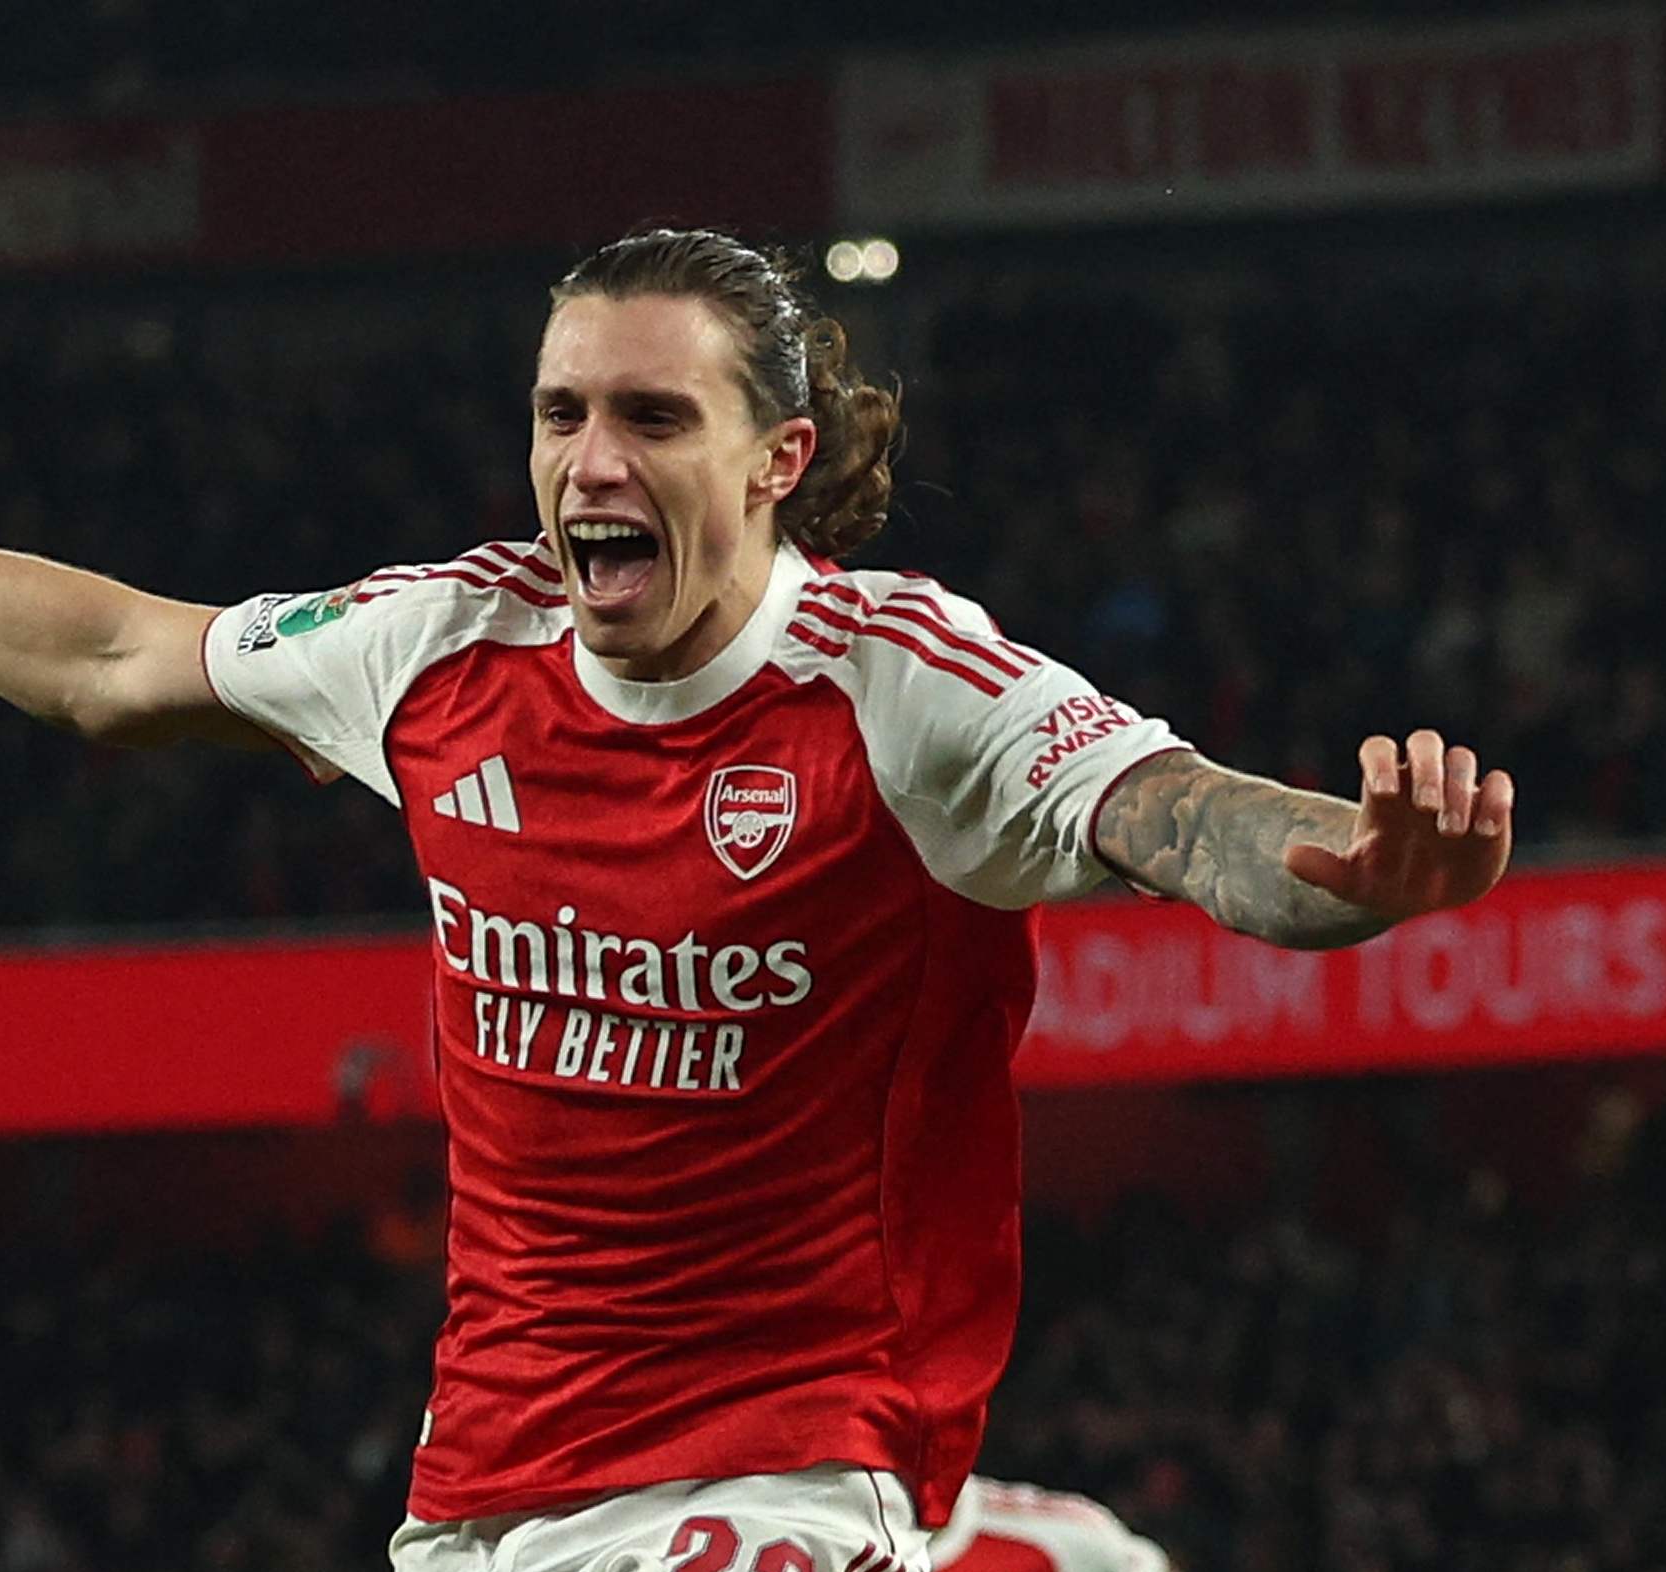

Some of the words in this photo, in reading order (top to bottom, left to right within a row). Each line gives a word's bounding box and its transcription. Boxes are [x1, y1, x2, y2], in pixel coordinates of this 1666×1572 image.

[719, 783, 785, 804] Arsenal
[1026, 709, 1130, 791] RWAN
[428, 876, 812, 1011] Emirates
[474, 992, 545, 1070] FLY
[554, 1008, 745, 1090] BETTER
